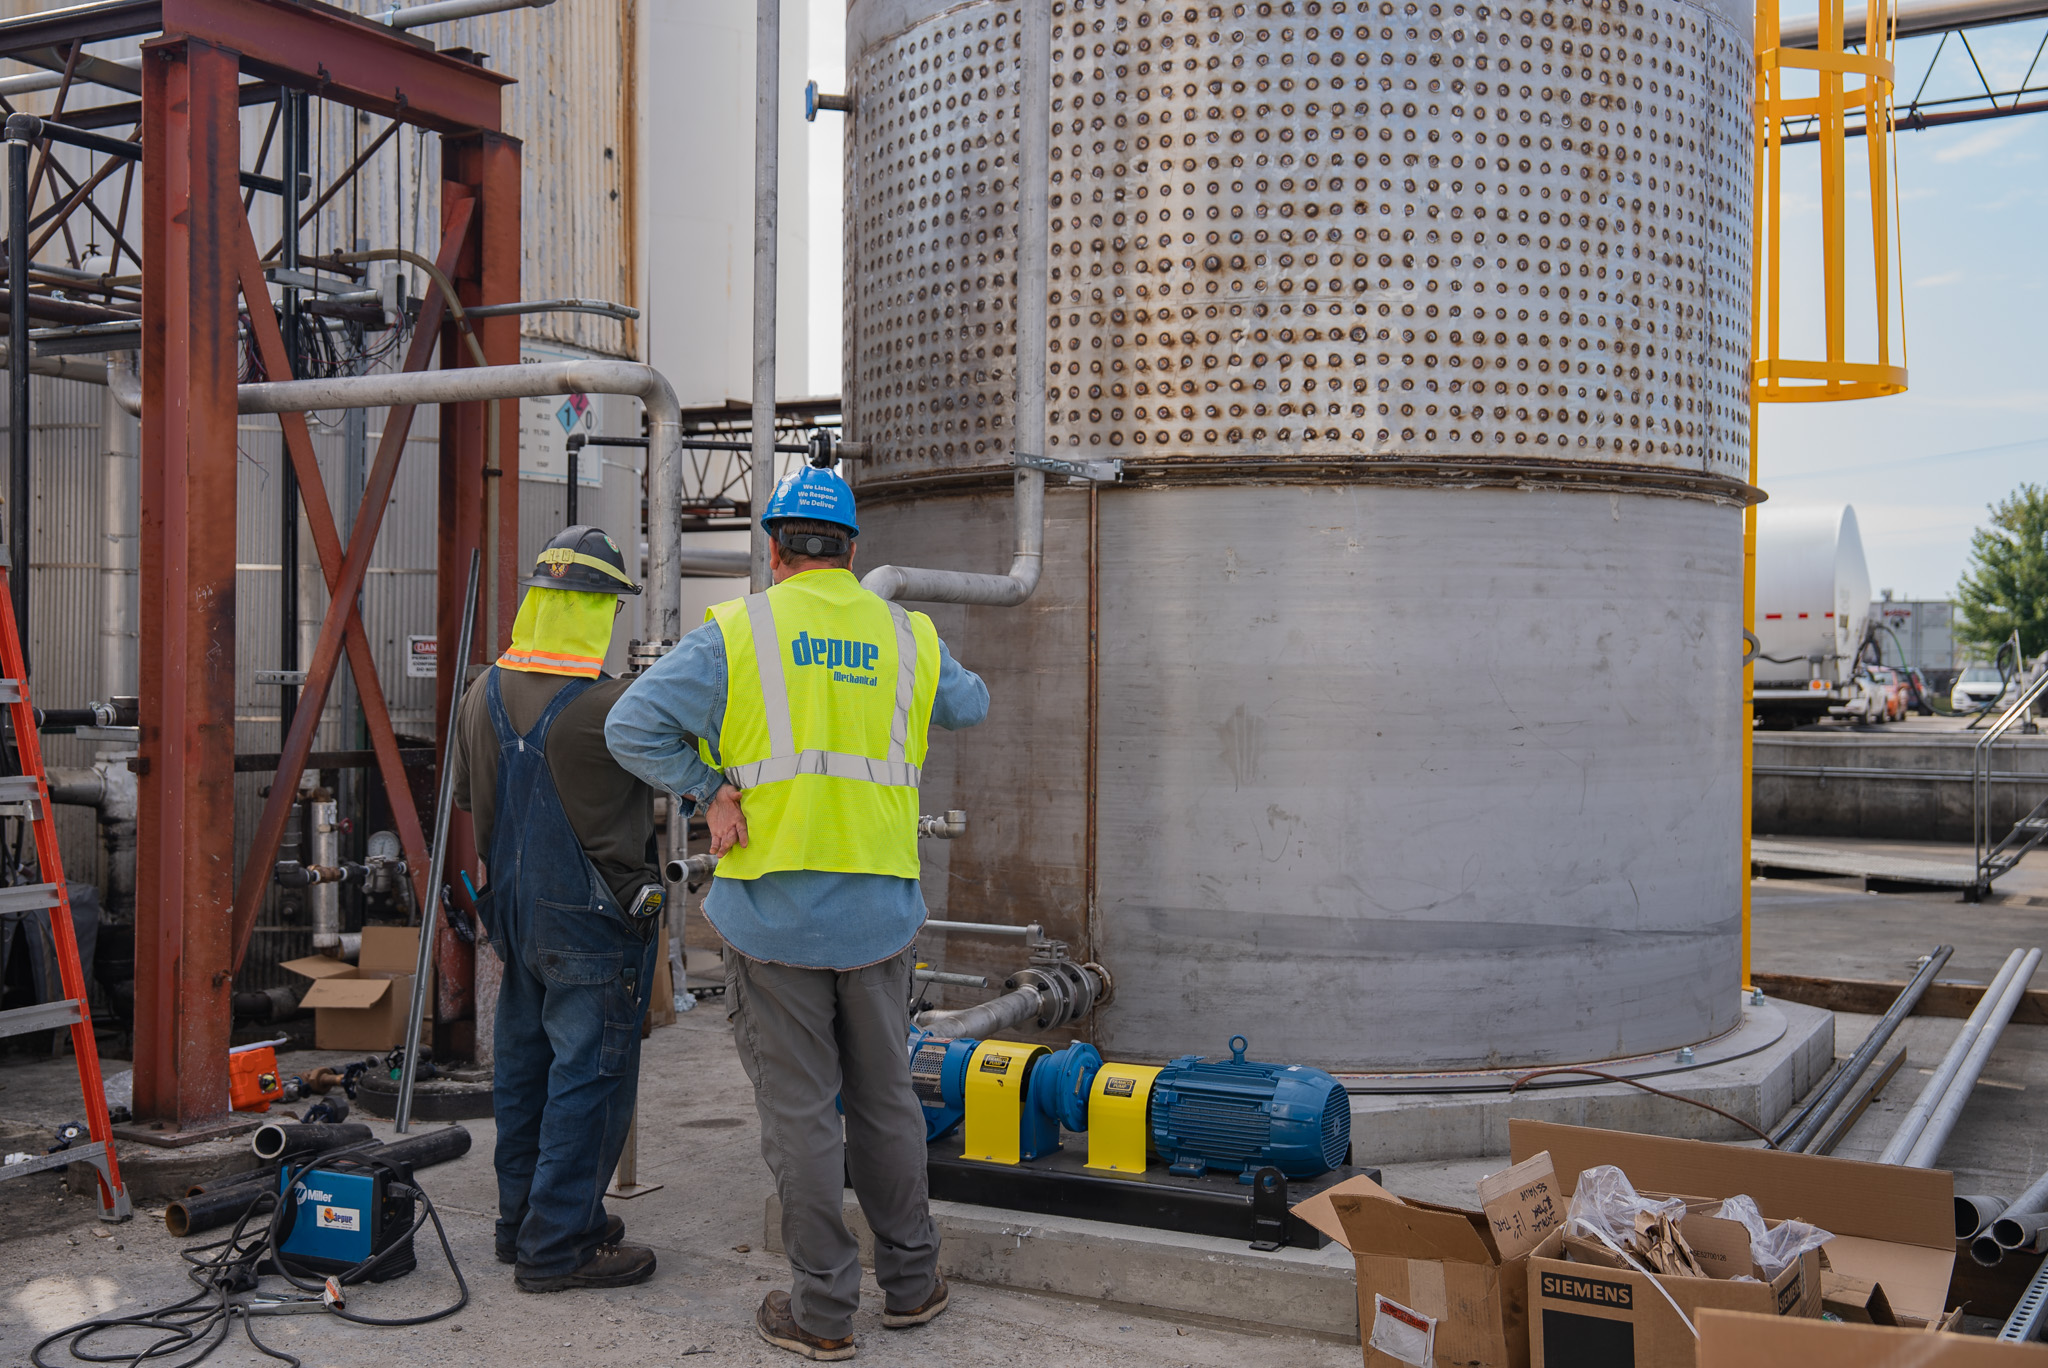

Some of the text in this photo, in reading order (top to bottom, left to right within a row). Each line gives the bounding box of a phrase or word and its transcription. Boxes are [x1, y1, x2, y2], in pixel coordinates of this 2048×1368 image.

[564, 407, 592, 430] 1 0
[814, 485, 834, 493] Listen
[810, 492, 837, 501] Respond
[811, 500, 834, 509] Deliver
[417, 643, 437, 651] DAN
[792, 630, 879, 671] depue
[834, 671, 878, 686] Mechanical
[308, 1189, 333, 1203] Miller
[1544, 1277, 1630, 1304] SIEMENS
[1780, 1277, 1800, 1313] SIEMEN
